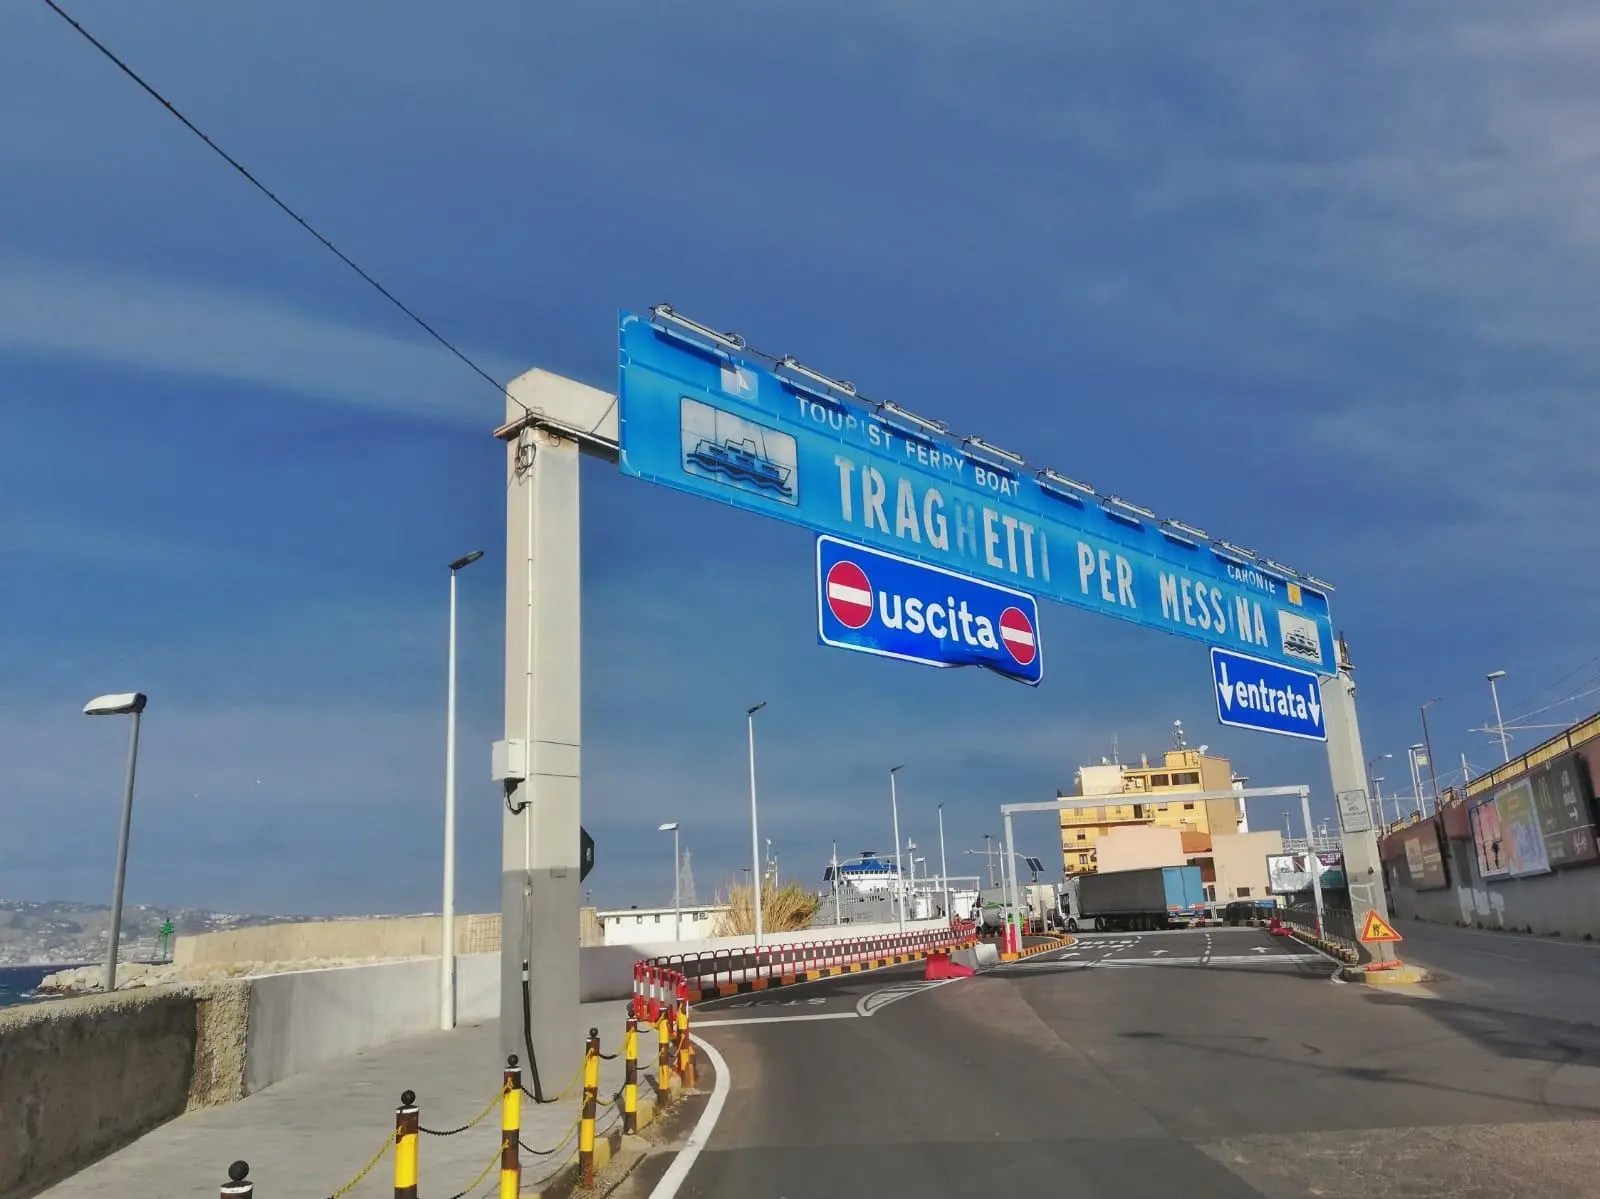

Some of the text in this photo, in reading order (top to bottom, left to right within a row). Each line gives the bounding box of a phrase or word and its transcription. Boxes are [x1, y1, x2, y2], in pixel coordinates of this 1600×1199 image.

[906, 441, 963, 474] FERRY
[975, 467, 1020, 497] BOAT
[834, 454, 1269, 648] TRAGHETTI PER MESSINA
[879, 591, 999, 650] uscita
[1236, 680, 1308, 720] entrata
